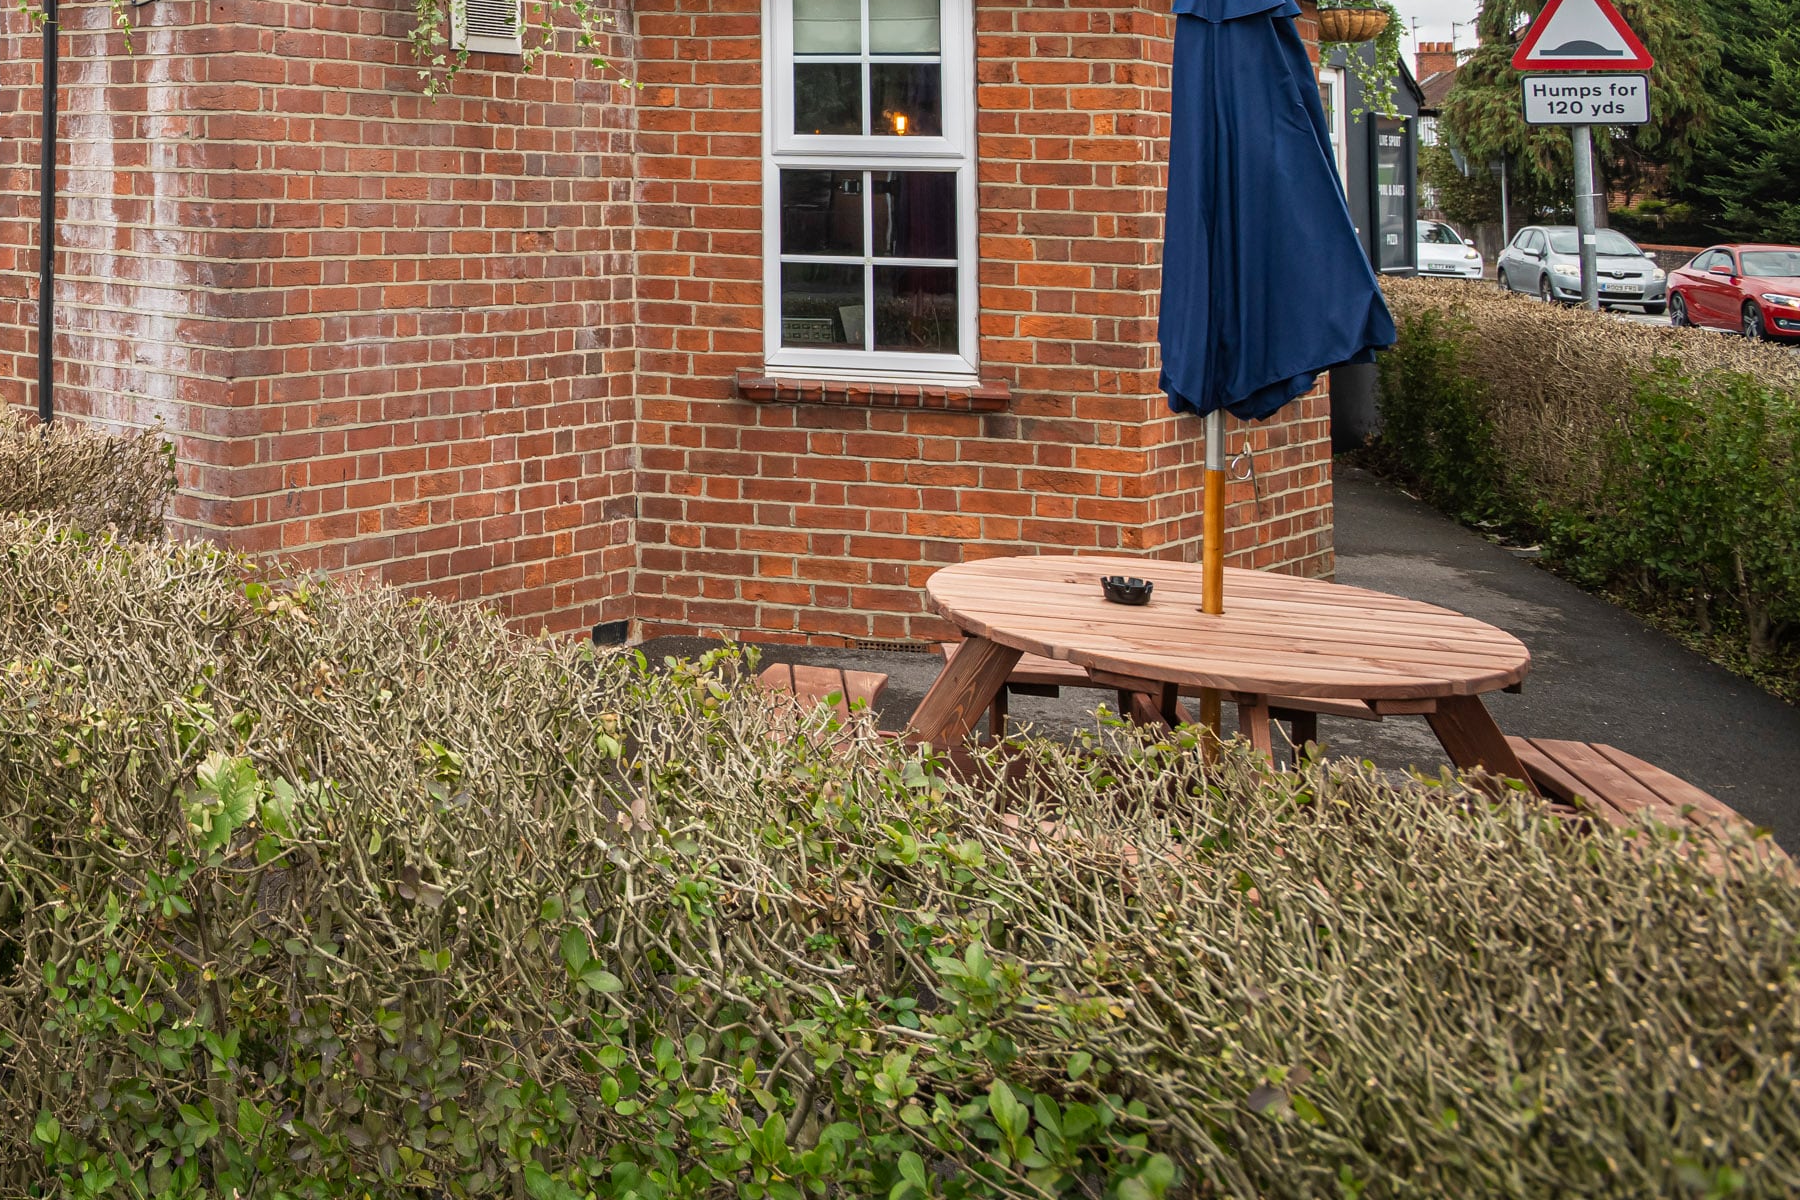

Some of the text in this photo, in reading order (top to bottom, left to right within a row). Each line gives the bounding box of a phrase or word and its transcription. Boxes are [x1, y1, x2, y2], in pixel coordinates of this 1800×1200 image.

[1533, 83, 1638, 99] Humps for
[1547, 101, 1625, 117] 120 yds
